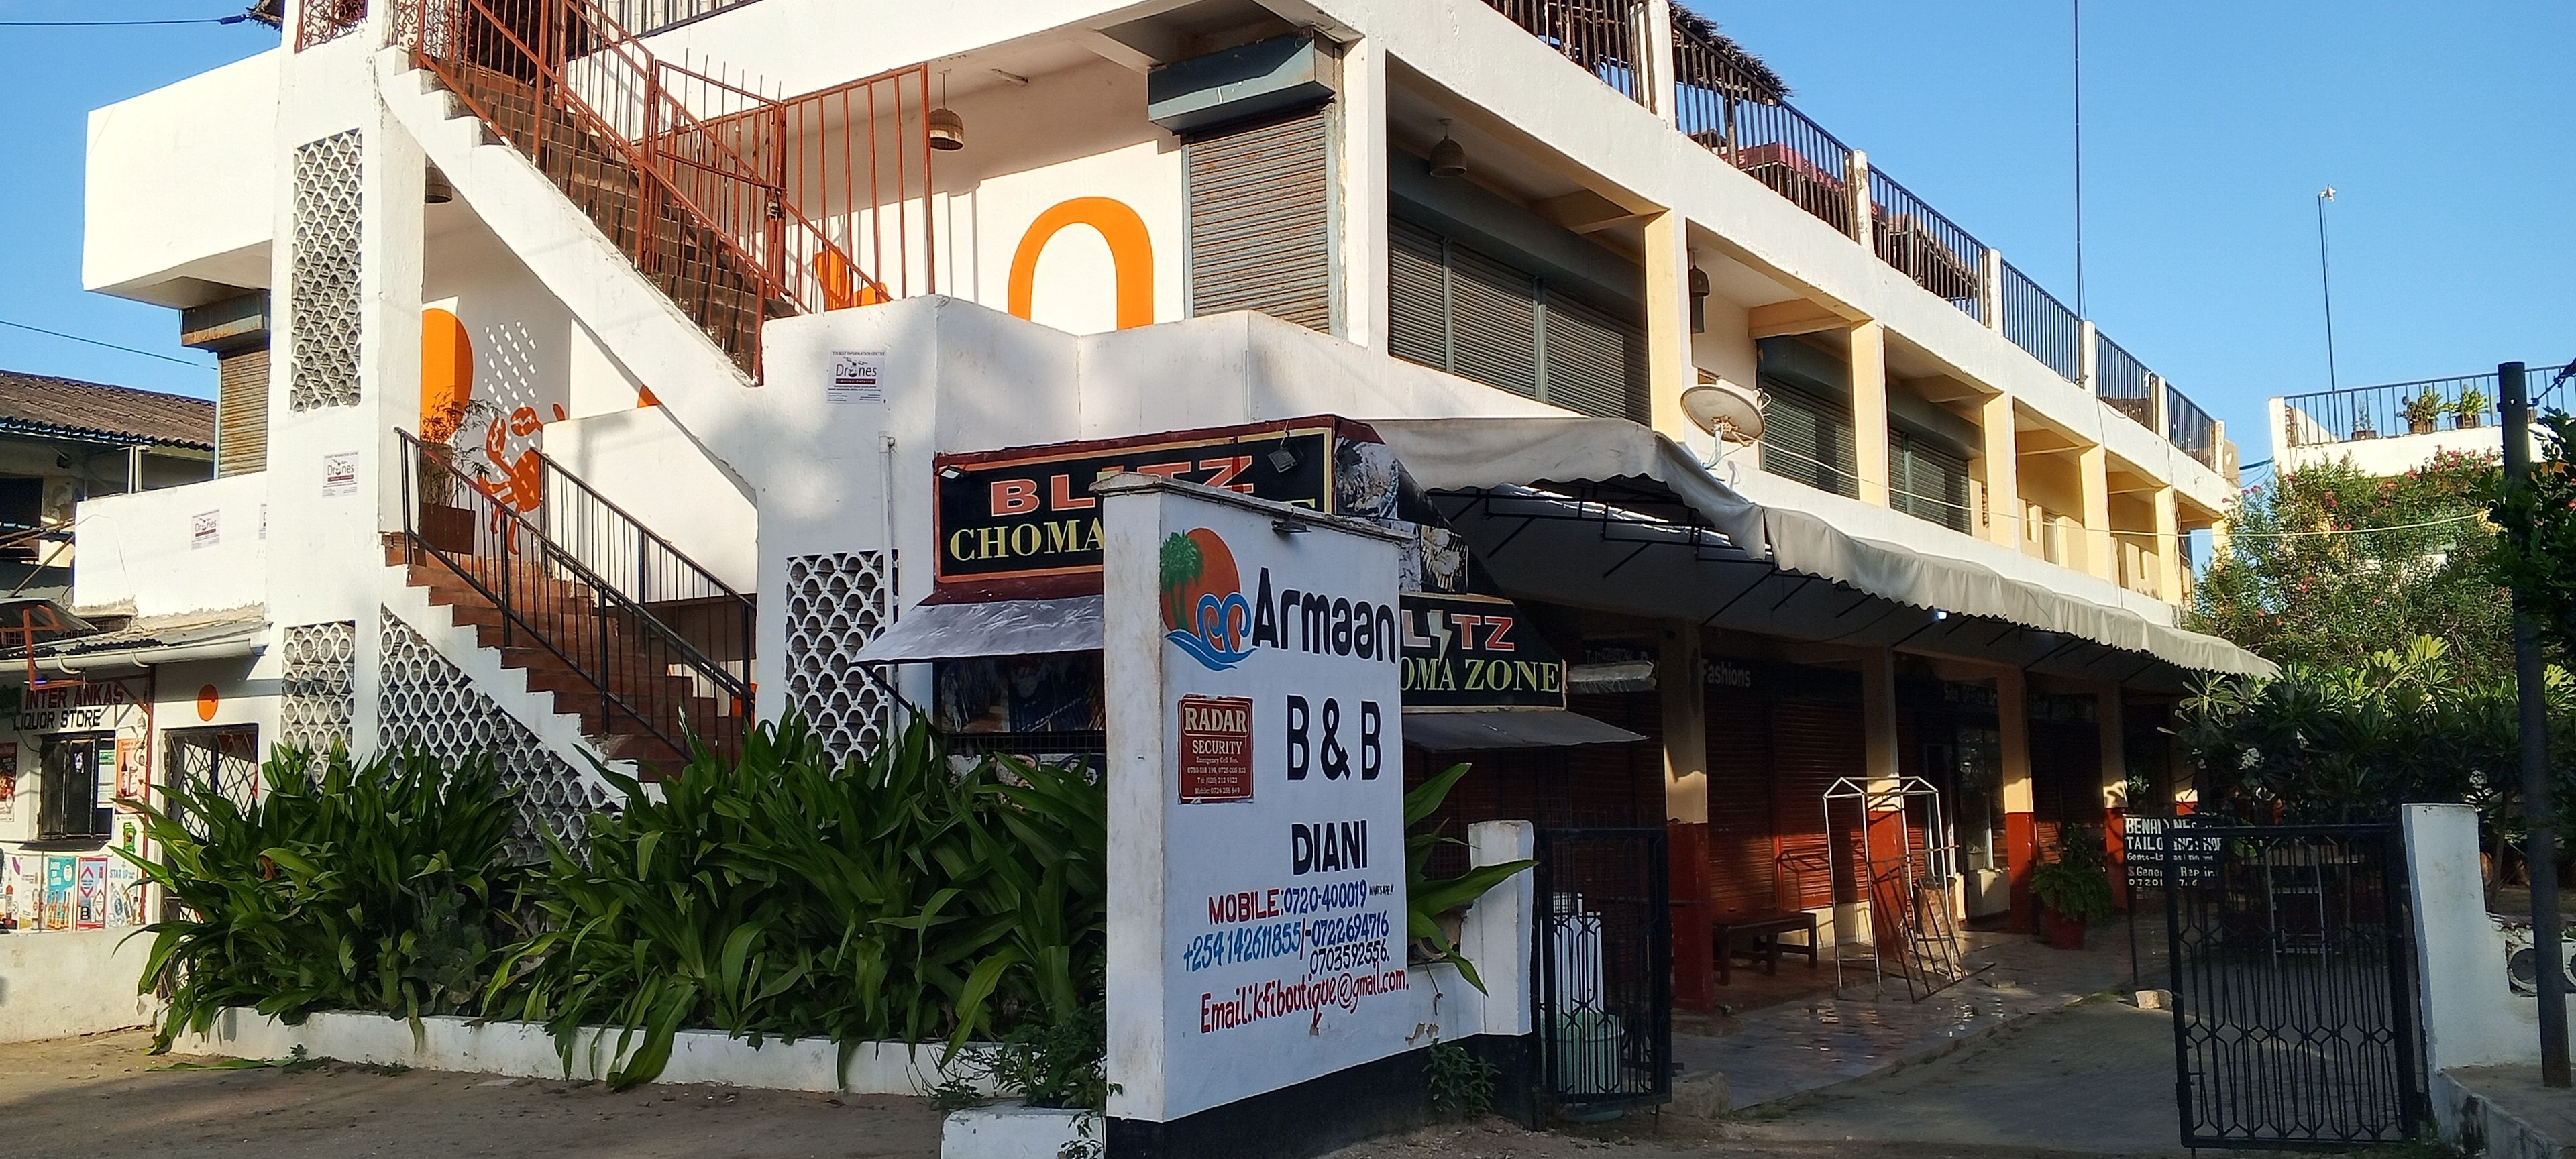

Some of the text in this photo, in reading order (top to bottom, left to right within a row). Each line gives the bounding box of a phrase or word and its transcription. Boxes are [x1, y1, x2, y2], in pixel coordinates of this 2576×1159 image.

[836, 363, 877, 378] Drones
[327, 465, 354, 476] Drones
[950, 517, 1104, 561] CHOMA
[1252, 567, 1397, 665] Armaan
[1464, 659, 1560, 692] ZONE
[1700, 659, 1751, 688] Fashions
[25, 683, 124, 710] INTER ANKAS
[13, 709, 101, 732] LIQUOR STORE
[1185, 707, 1248, 732] RADAR
[1192, 740, 1242, 755] SECURITY
[1287, 694, 1382, 781] B & B
[1291, 820, 1368, 875] DIANI
